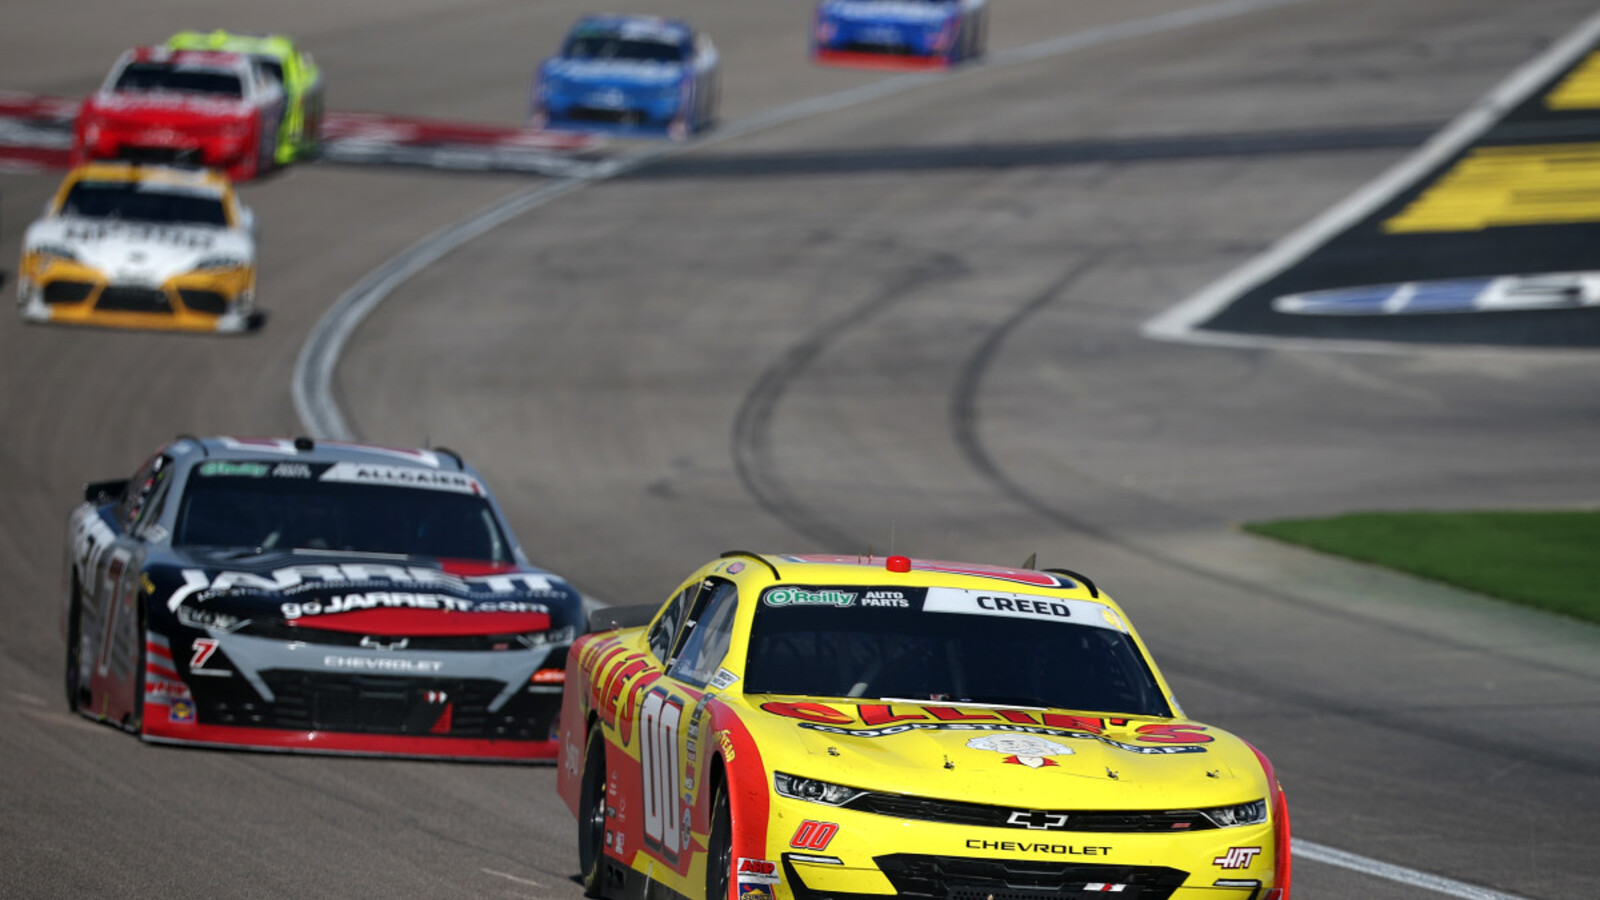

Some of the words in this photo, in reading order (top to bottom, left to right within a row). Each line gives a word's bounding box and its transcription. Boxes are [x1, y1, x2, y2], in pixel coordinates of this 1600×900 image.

[357, 465, 467, 487] ALLGAIER
[764, 587, 858, 607] O'Reilly
[861, 599, 909, 608] PARTS
[865, 591, 904, 599] AUTO
[976, 596, 1071, 617] CREED
[189, 637, 219, 669] 7
[324, 655, 443, 673] CHEVROLET
[640, 685, 683, 867] 00
[790, 819, 840, 851] 00
[966, 839, 1113, 856] CHEVROLET
[740, 860, 776, 875] ARP
